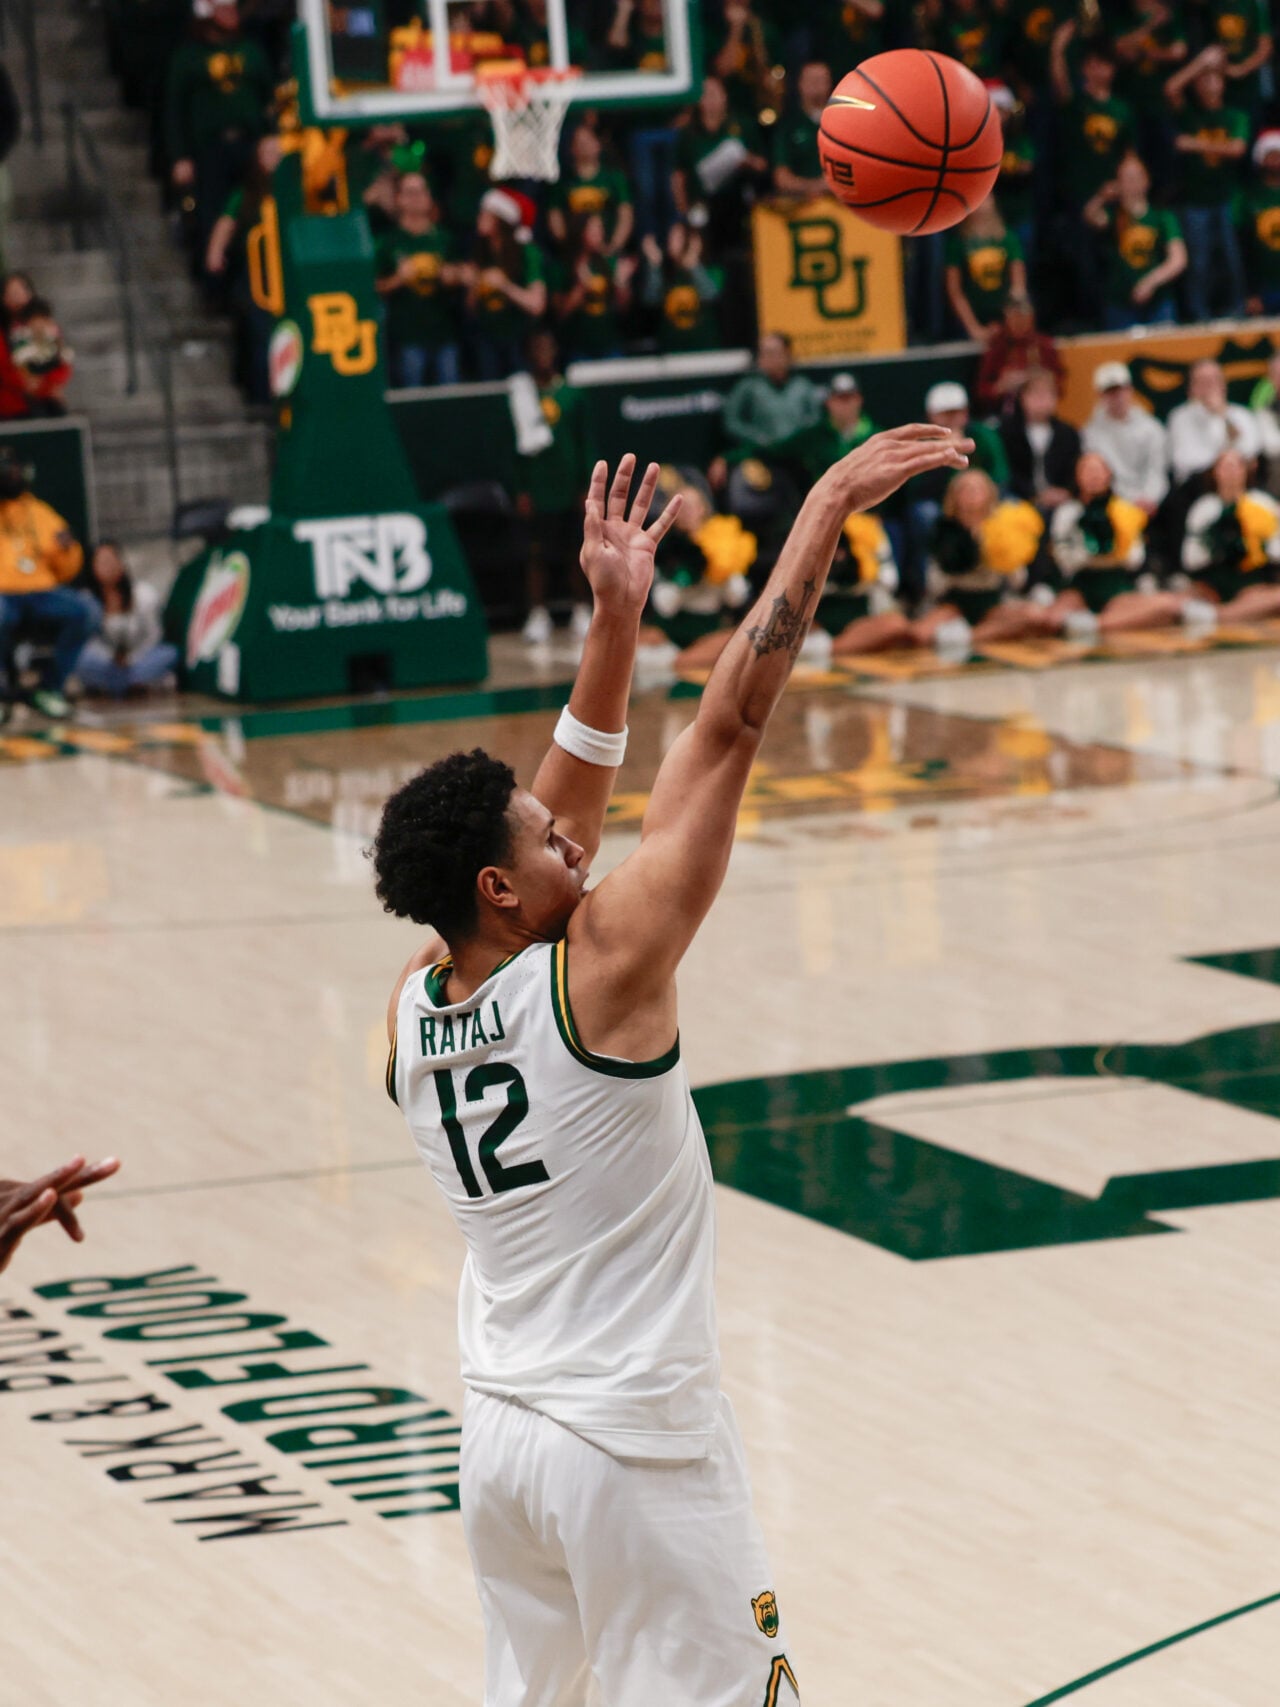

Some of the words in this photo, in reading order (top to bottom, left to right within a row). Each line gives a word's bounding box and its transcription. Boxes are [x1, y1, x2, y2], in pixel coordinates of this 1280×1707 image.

[787, 216, 870, 320] BU
[307, 292, 378, 376] BU
[269, 604, 321, 631] Your
[324, 596, 383, 628] Bank
[385, 595, 419, 621] for
[420, 589, 467, 619] Life
[419, 1001, 506, 1057] RATAJ
[433, 1062, 551, 1198] 12
[32, 1263, 370, 1389] FLOOR
[30, 1393, 172, 1423] &
[63, 1424, 350, 1541] MARK
